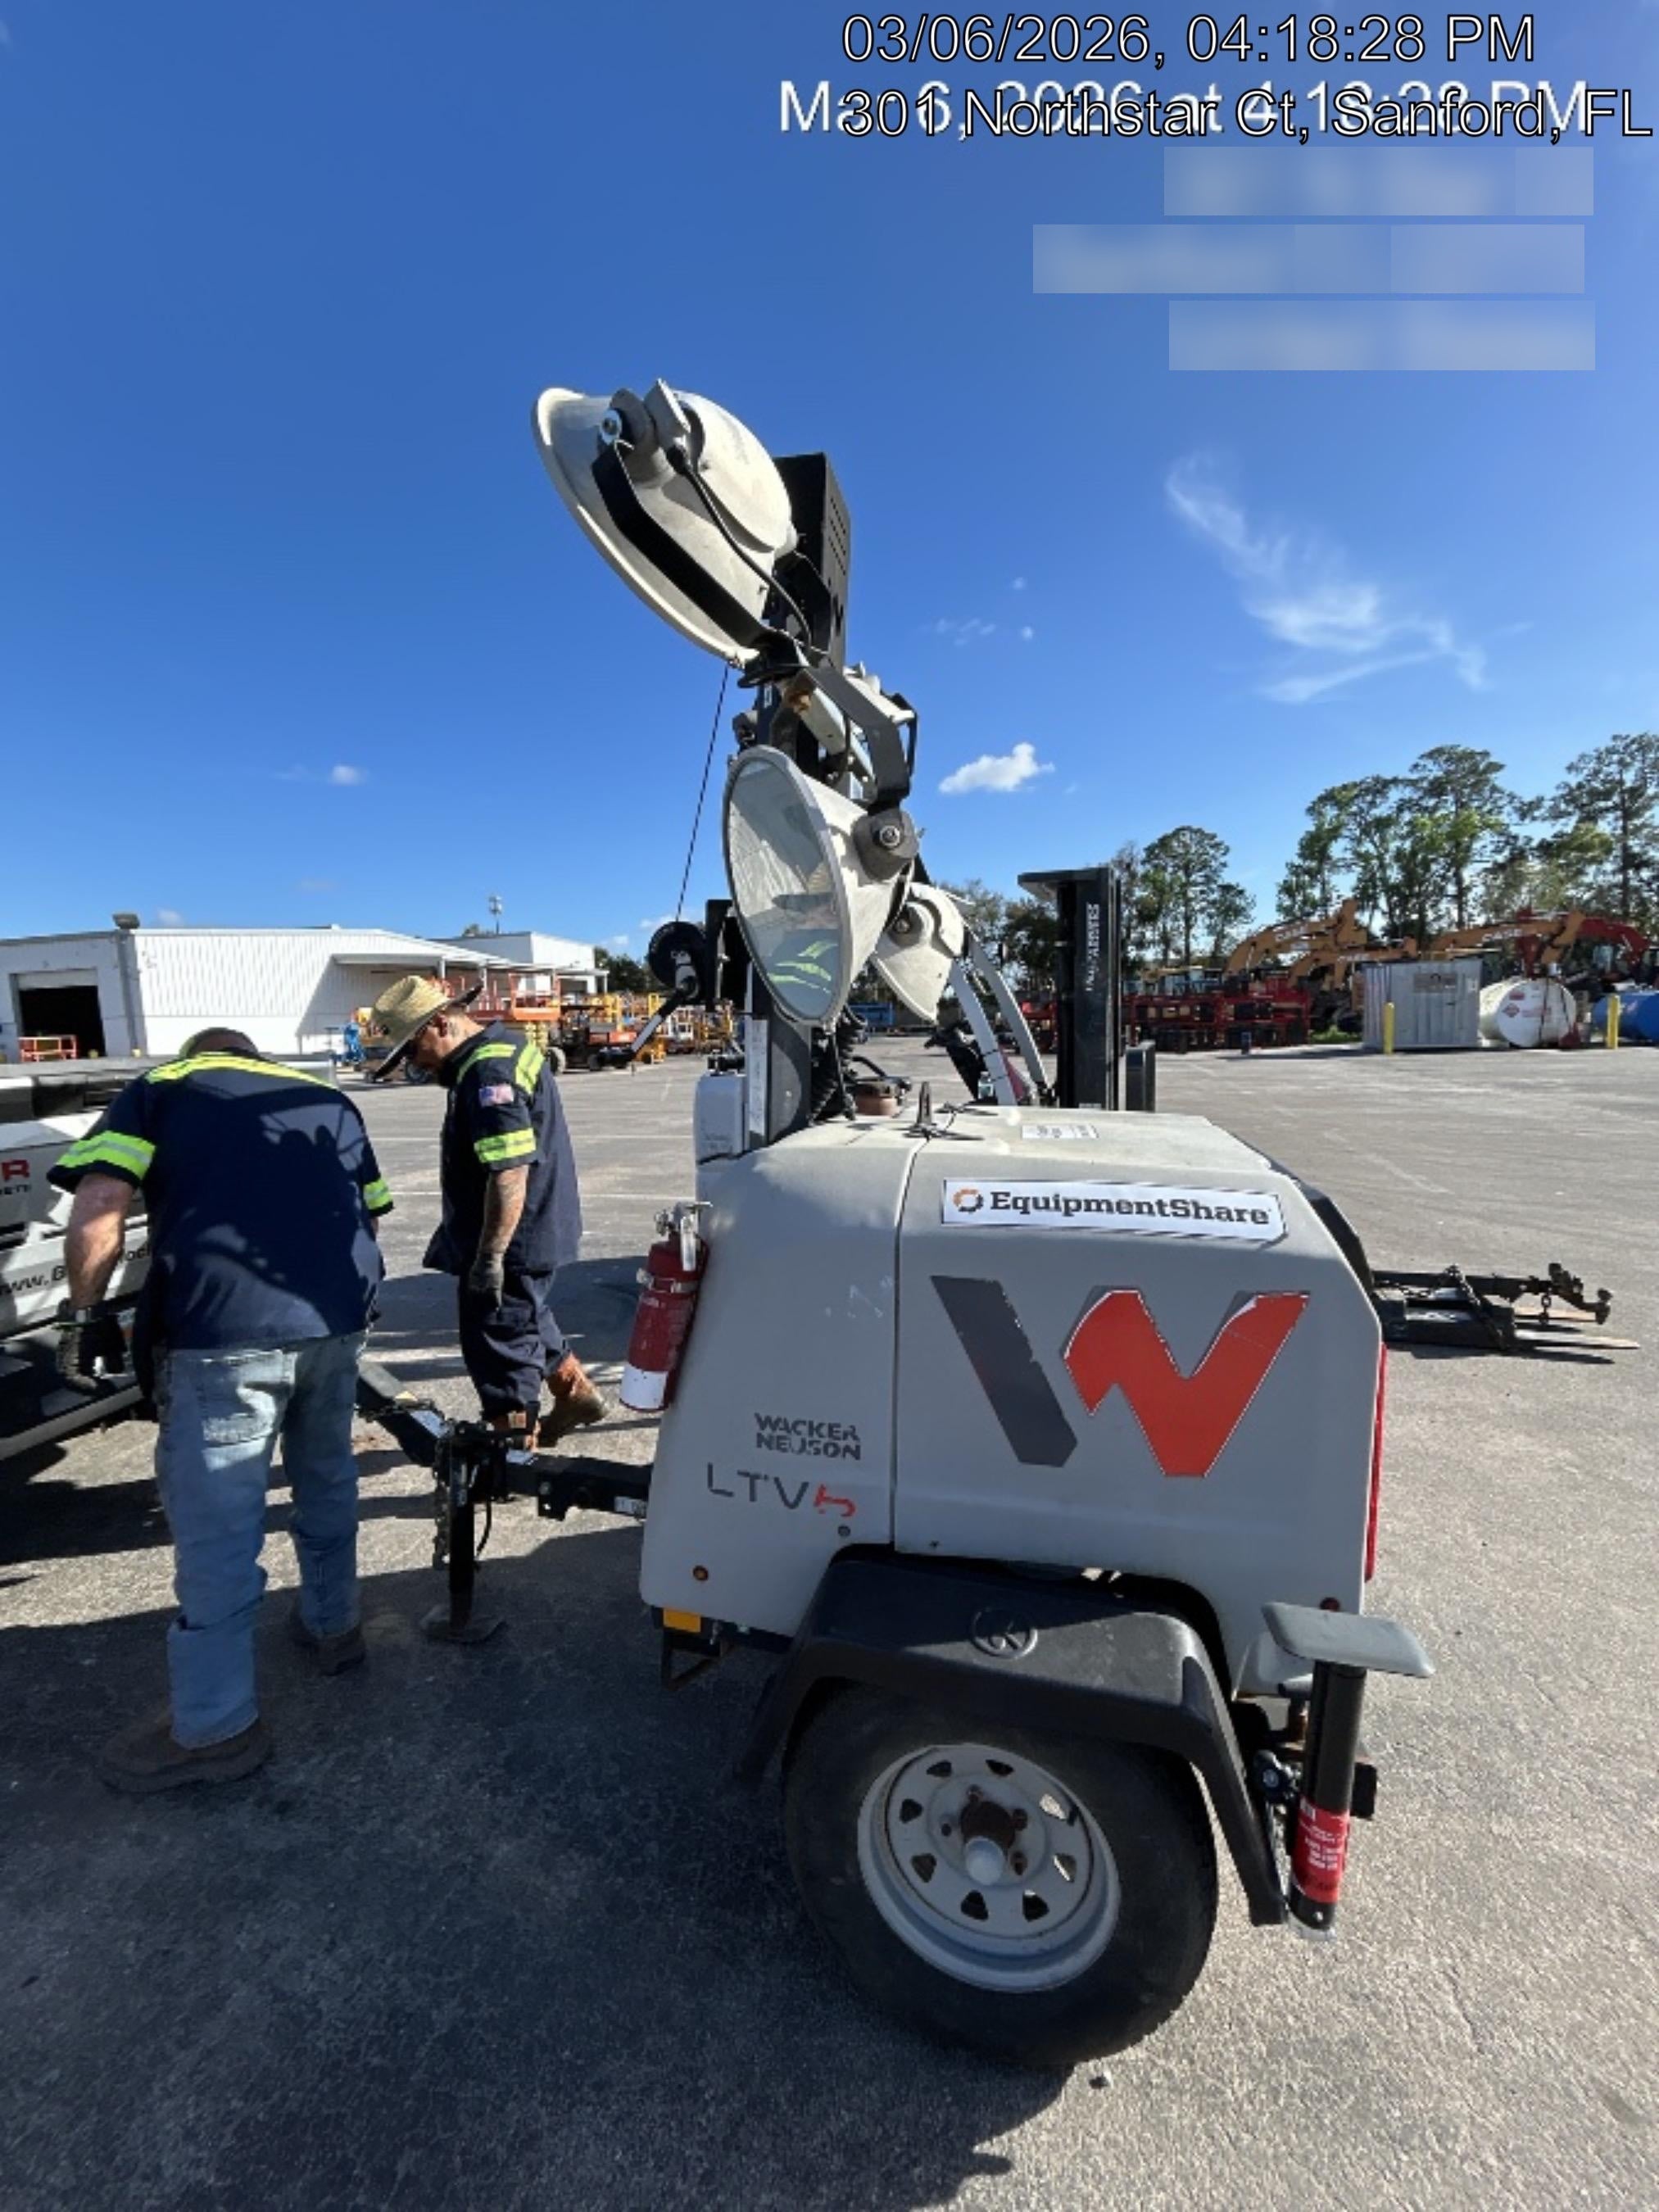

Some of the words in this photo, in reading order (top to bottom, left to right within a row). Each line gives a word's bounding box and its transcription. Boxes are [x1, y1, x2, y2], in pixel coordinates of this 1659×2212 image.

[990, 1190, 1271, 1225] EquipmentShare
[754, 1412, 859, 1441] WACKER
[755, 1432, 862, 1461] NEUSON
